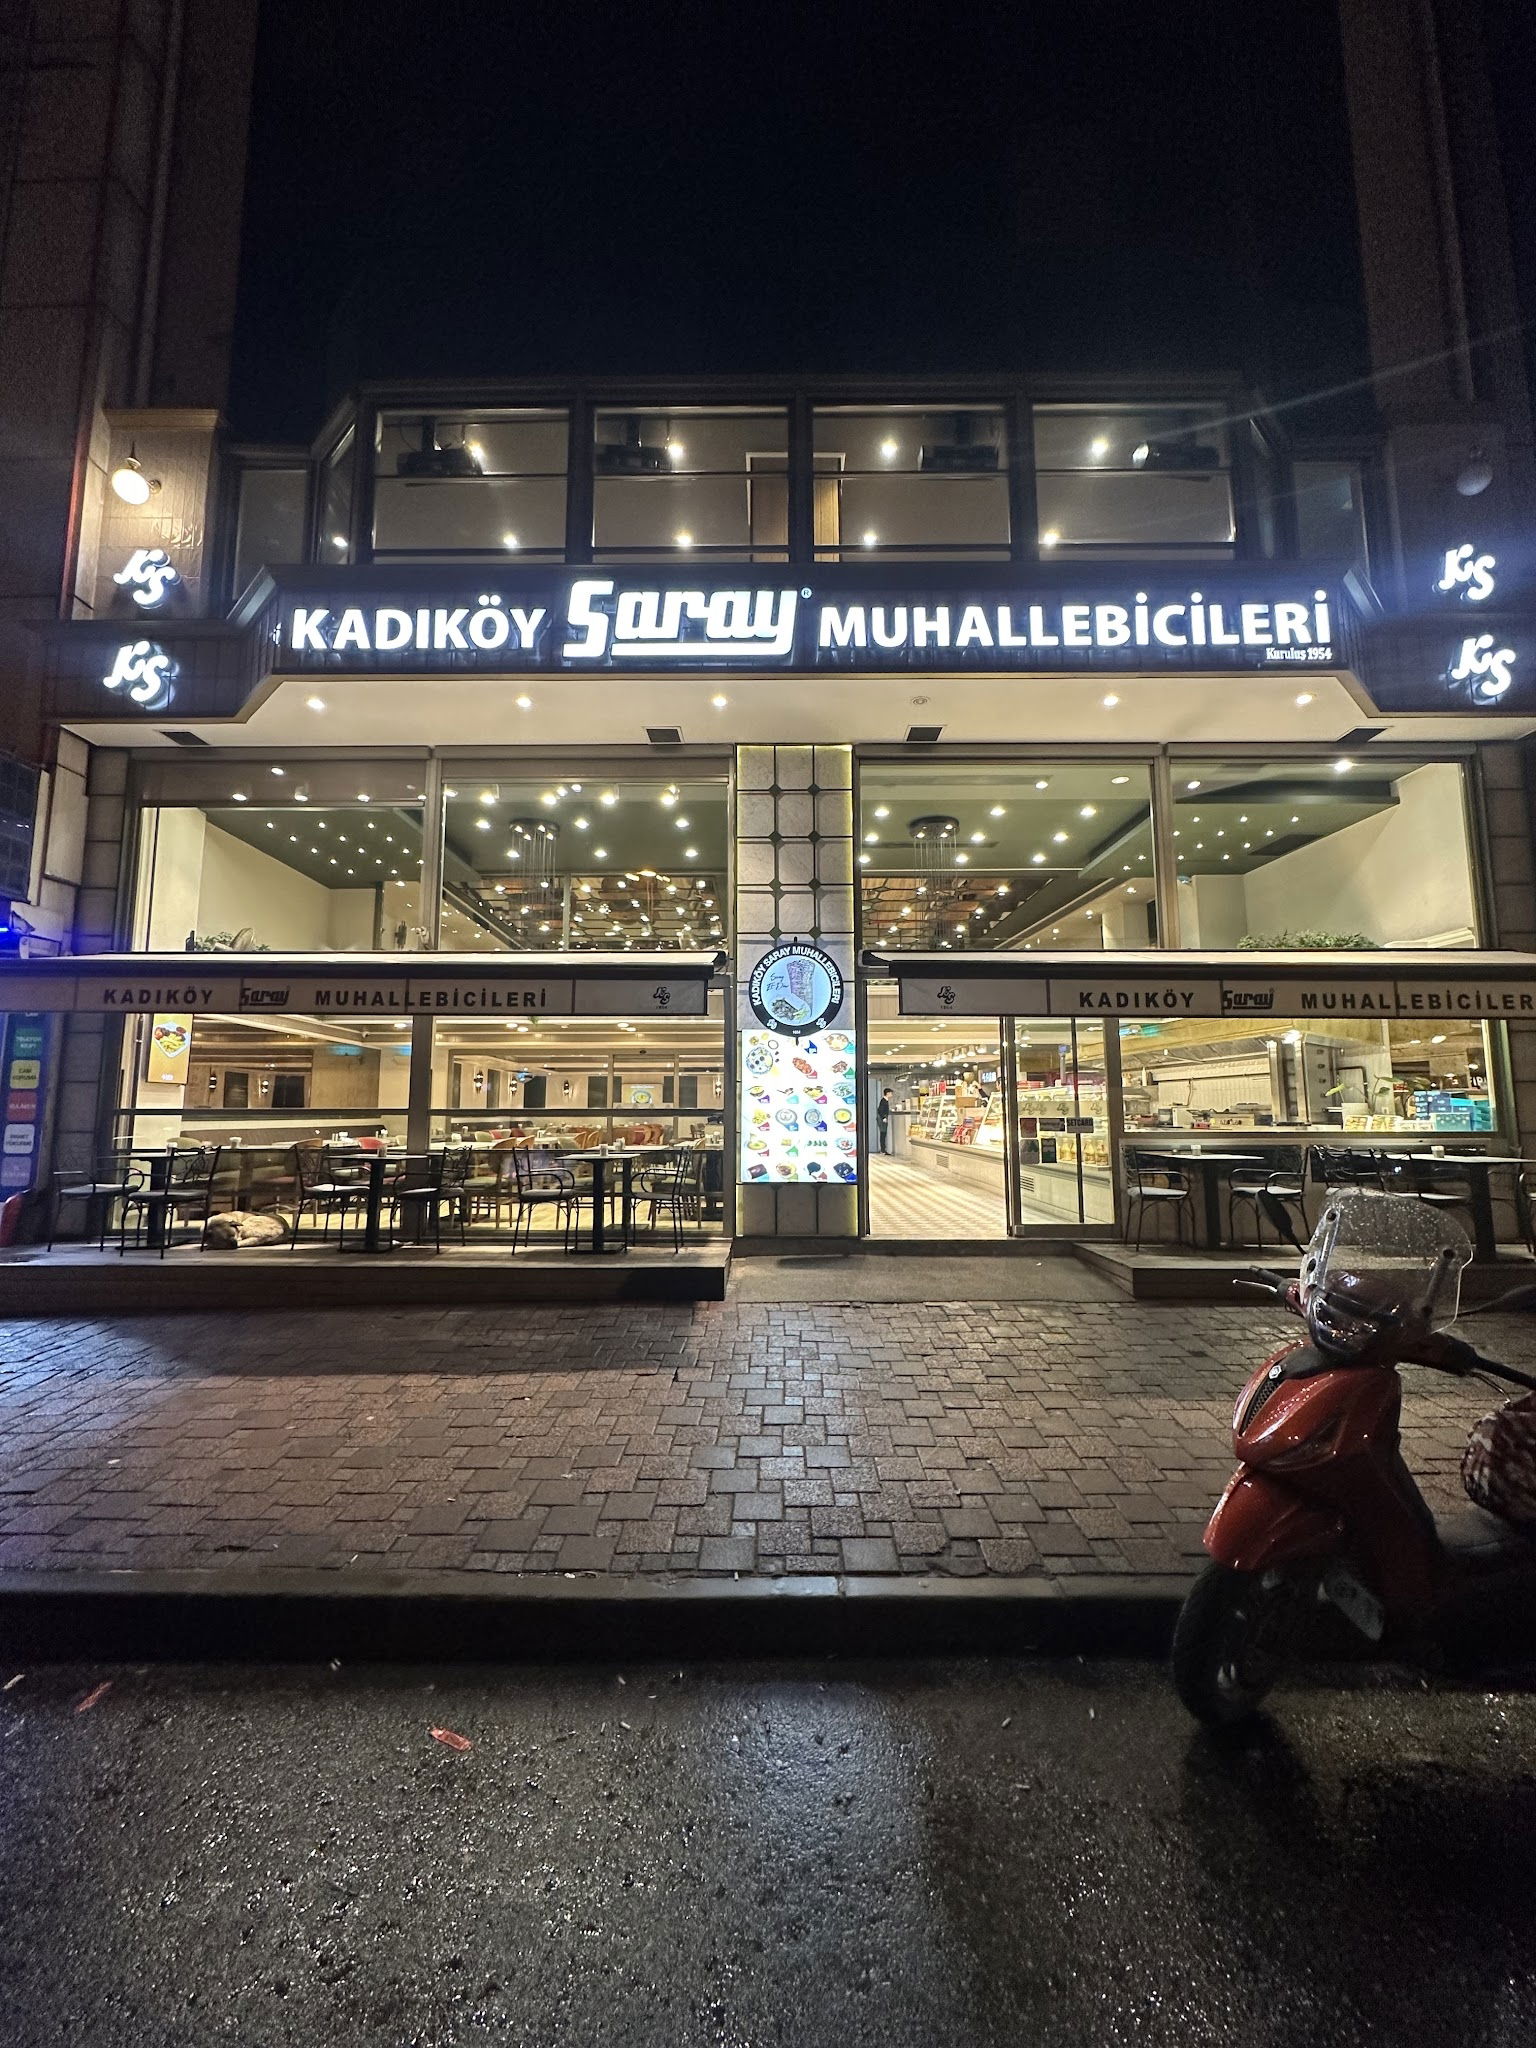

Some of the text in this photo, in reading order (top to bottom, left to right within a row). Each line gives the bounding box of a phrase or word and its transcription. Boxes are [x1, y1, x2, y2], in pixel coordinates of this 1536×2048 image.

[291, 580, 1331, 658] KADIKÖY Saray MUHALLEBİCİLERİ
[1307, 647, 1333, 660] 1954
[763, 946, 791, 967] SARAY
[103, 986, 547, 1007] KADIKÖY Saray MUHALLEBİCİLERİ
[1079, 988, 1195, 1008] KADIKÖY
[1223, 989, 1275, 1009] Saray
